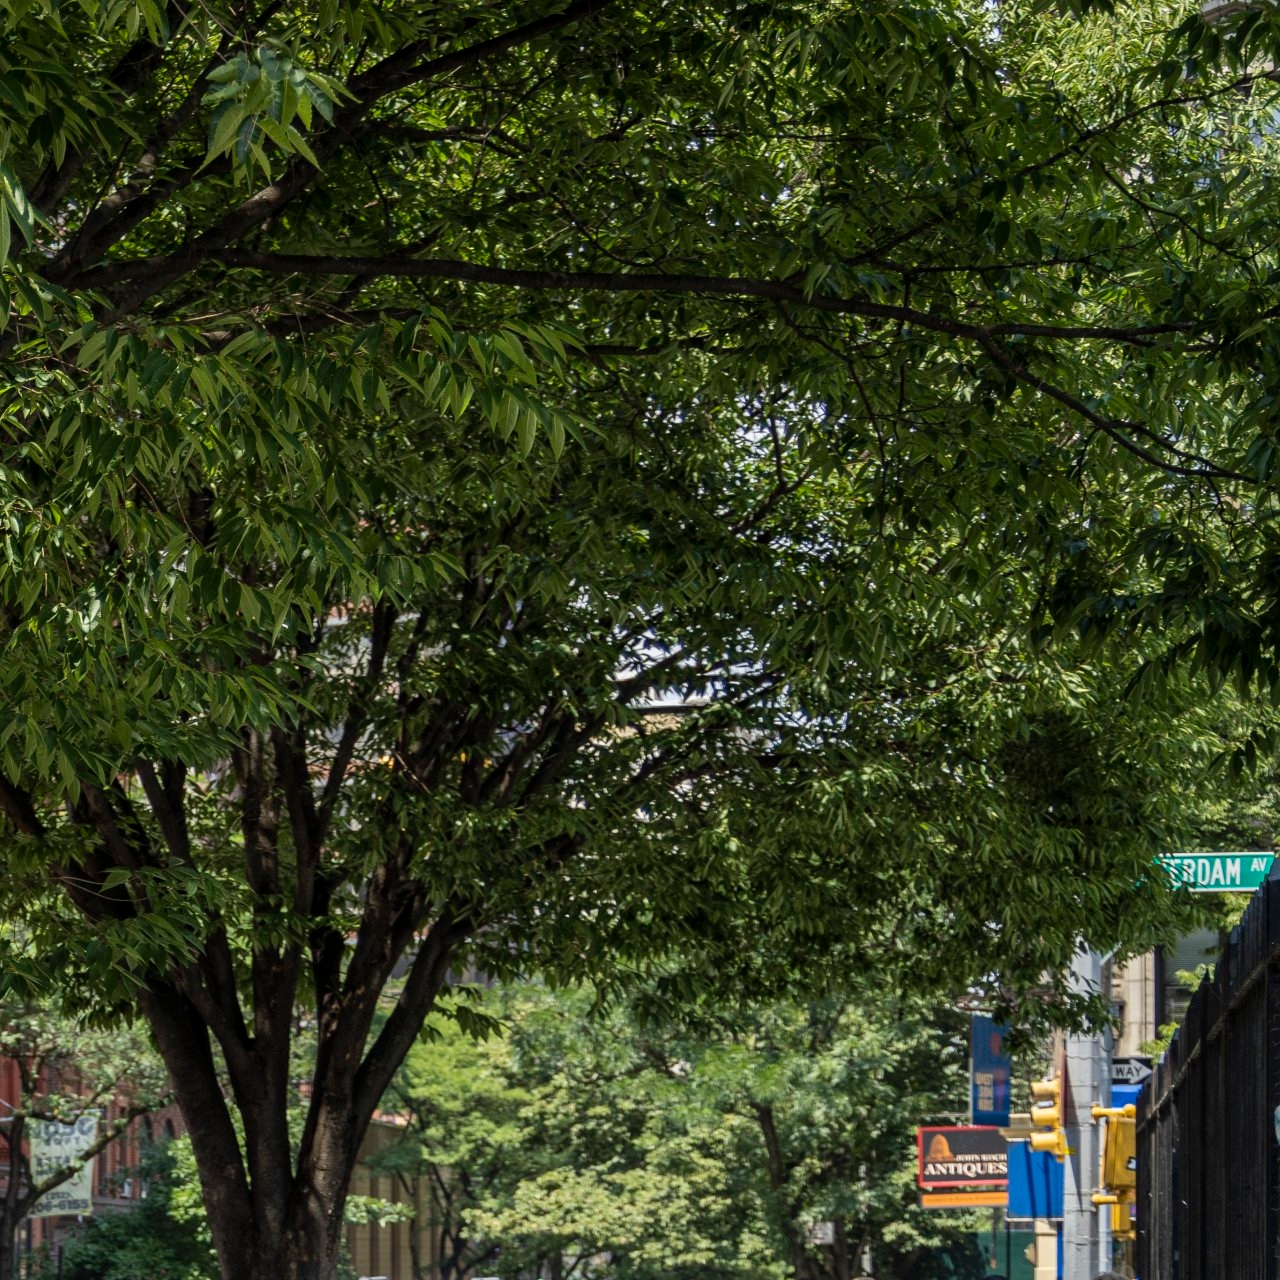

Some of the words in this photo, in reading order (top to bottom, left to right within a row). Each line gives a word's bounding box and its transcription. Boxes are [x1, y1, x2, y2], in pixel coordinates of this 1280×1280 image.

[1166, 857, 1241, 887] ERDAM
[1115, 1066, 1143, 1077] WAY
[923, 1162, 1008, 1178] ANTIQUES
